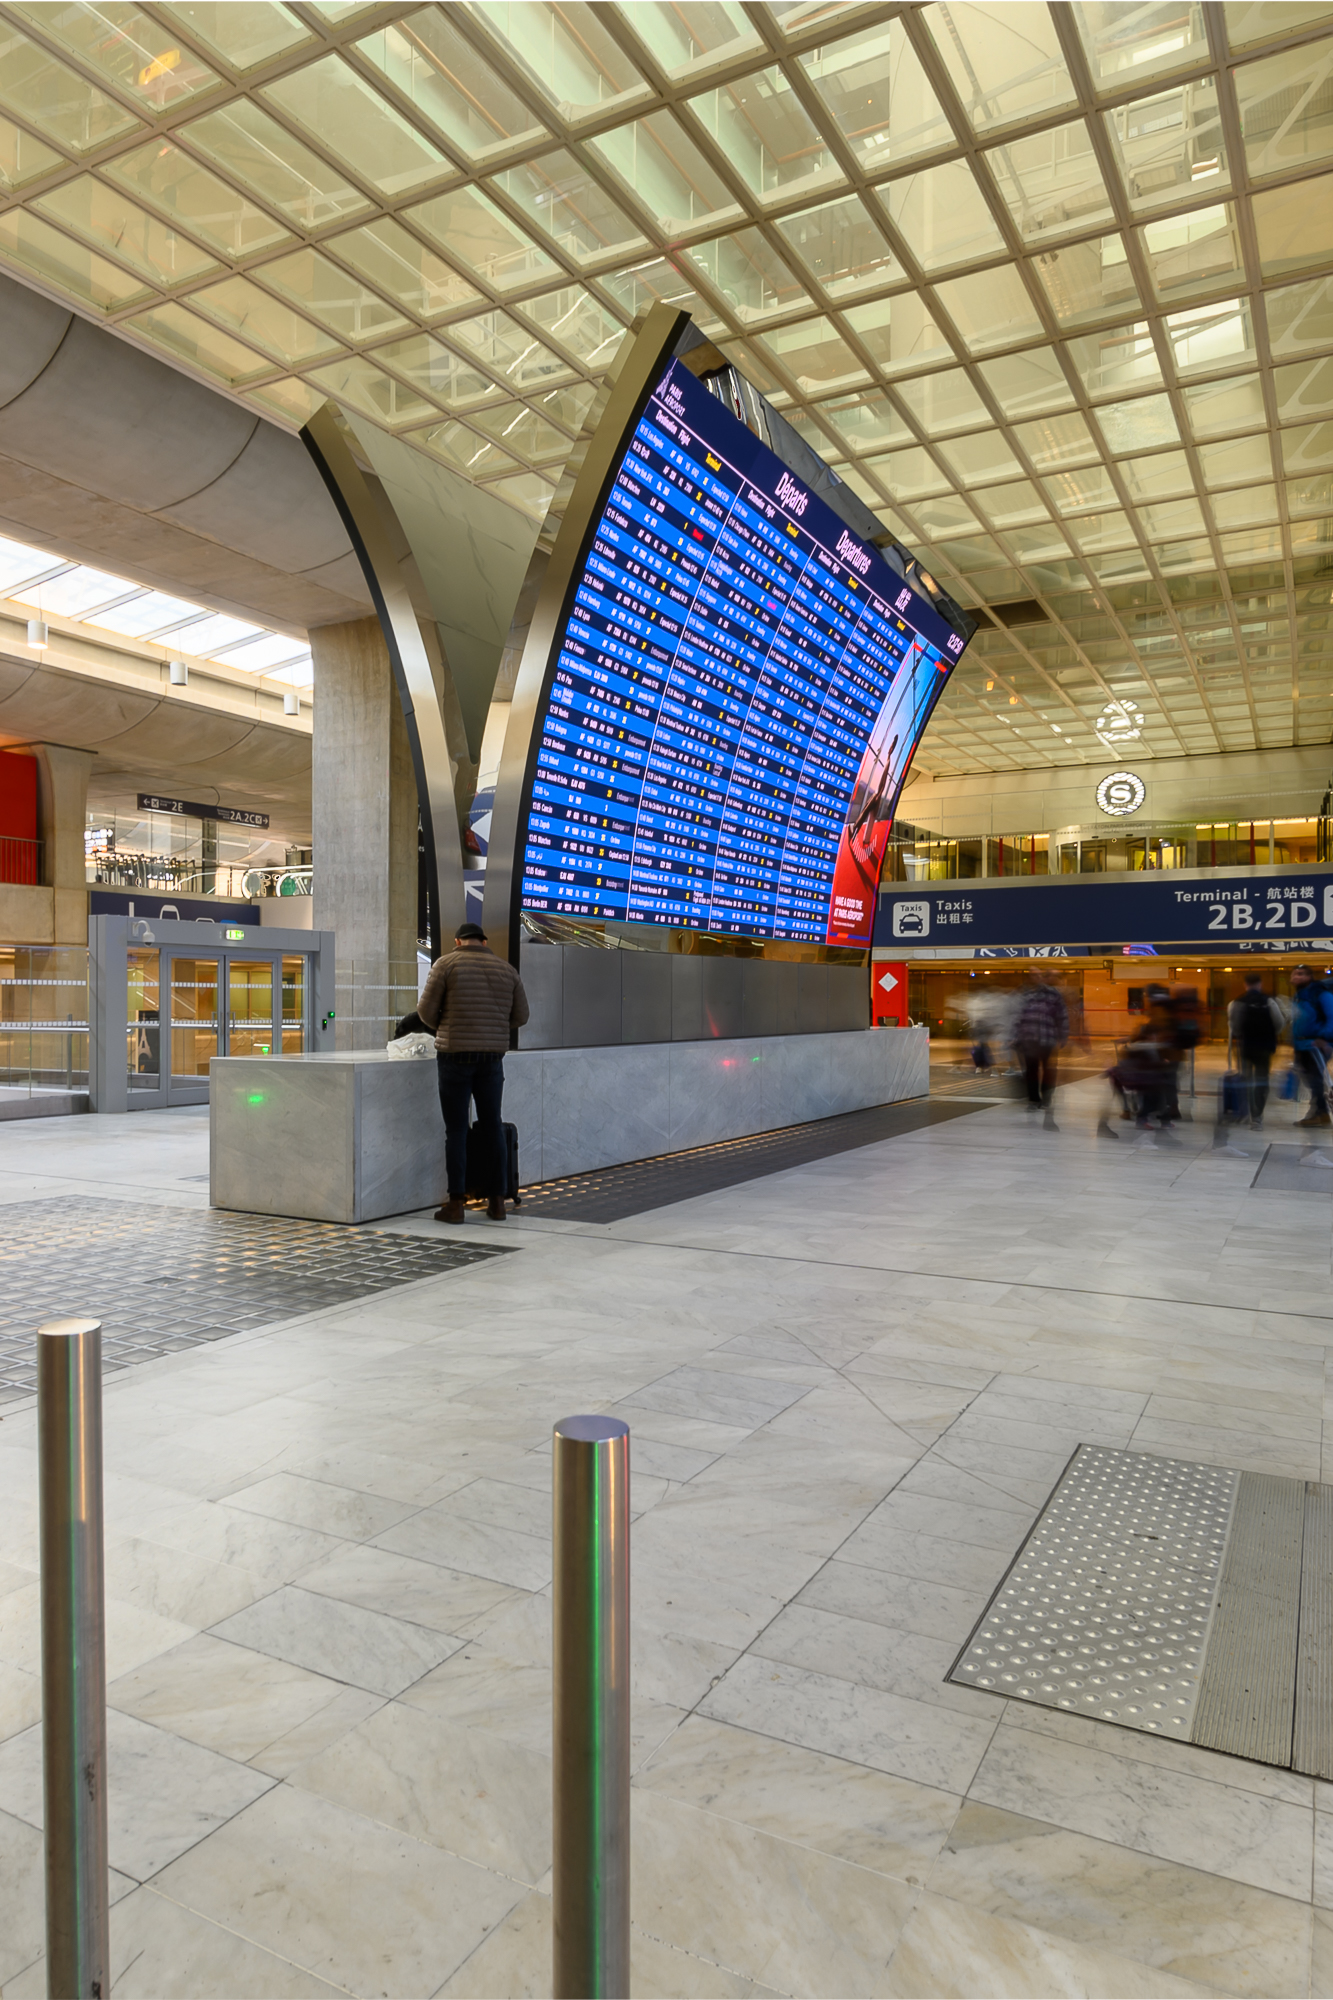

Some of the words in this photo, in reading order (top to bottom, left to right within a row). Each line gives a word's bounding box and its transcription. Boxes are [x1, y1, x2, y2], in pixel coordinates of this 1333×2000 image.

[774, 472, 808, 516] Départs
[836, 530, 872, 575] Departures
[172, 802, 183, 812] 2E
[1175, 888, 1247, 902] Terminal
[1267, 886, 1314, 899] 航站楼
[936, 900, 972, 911] Taxis
[936, 913, 973, 924] 出租车
[1208, 902, 1316, 930] 2B,2D
